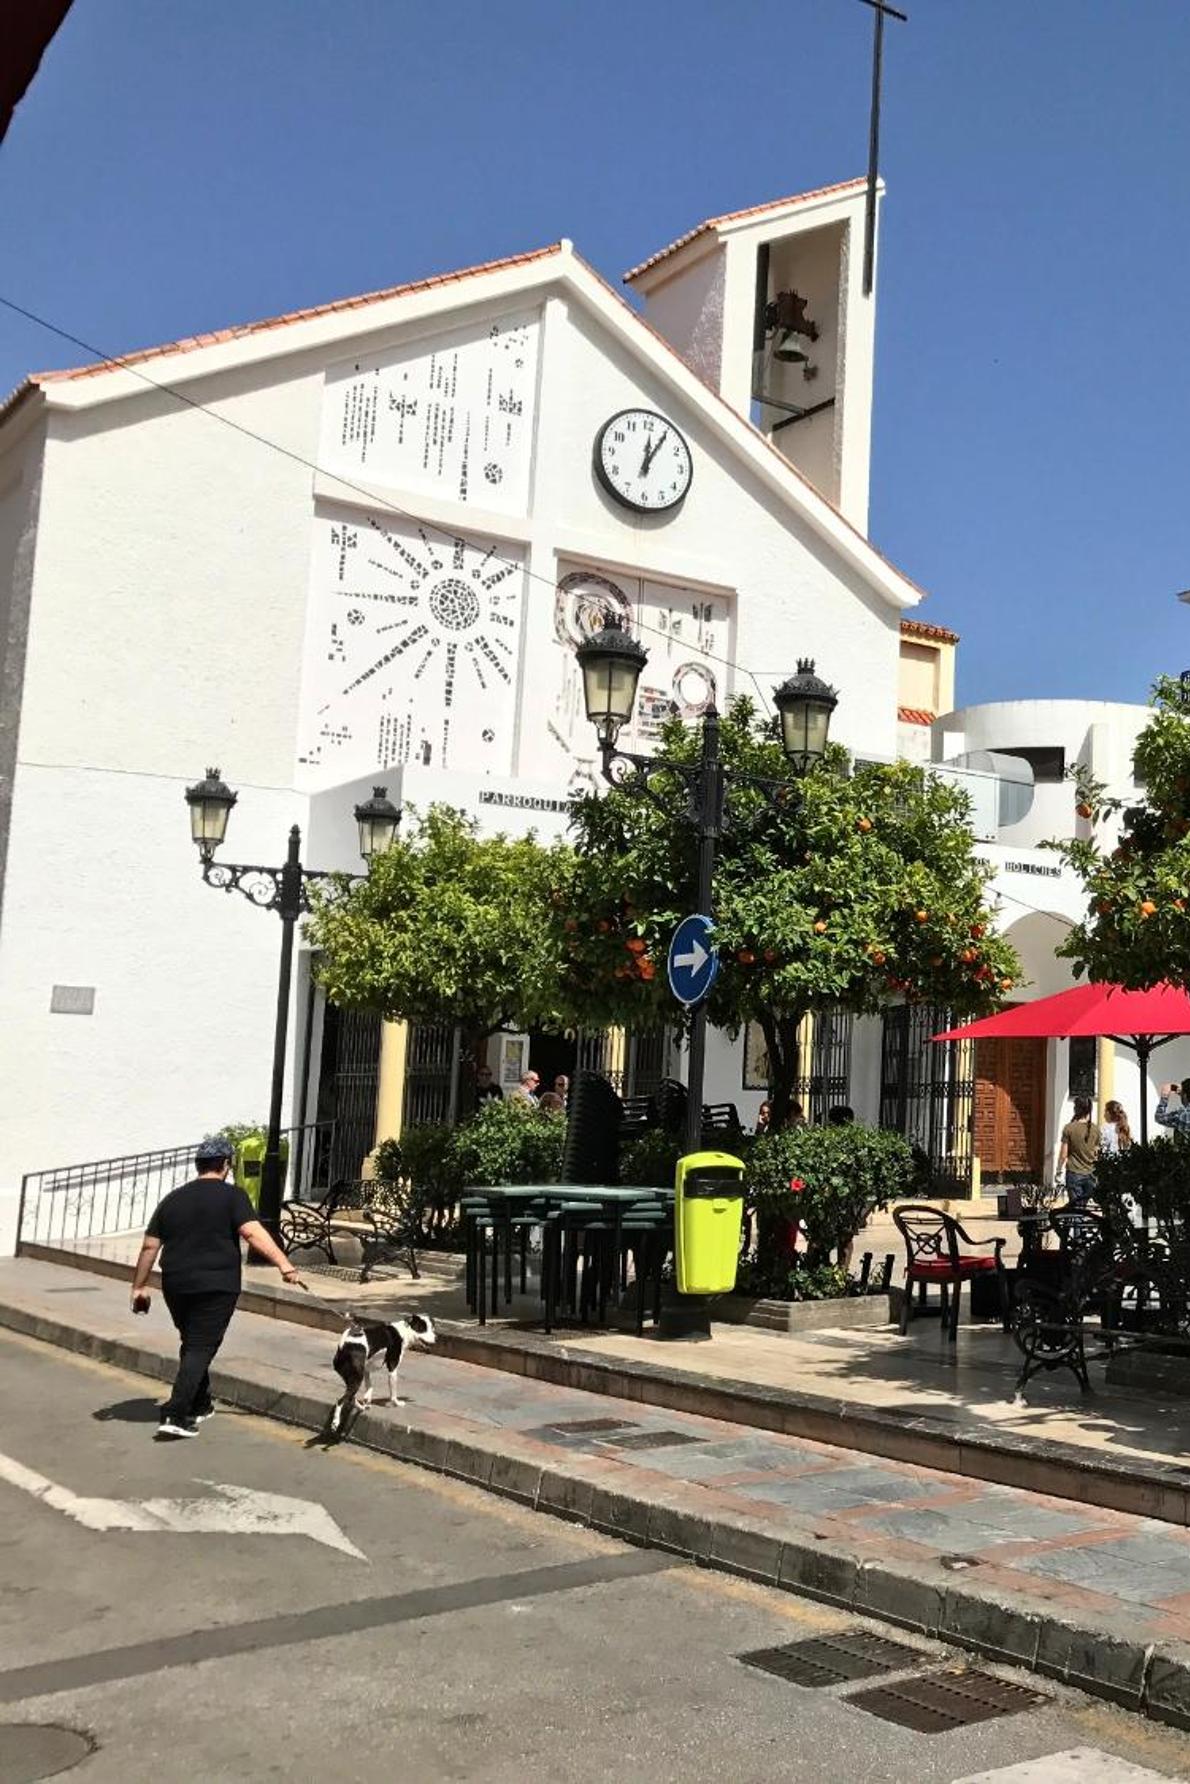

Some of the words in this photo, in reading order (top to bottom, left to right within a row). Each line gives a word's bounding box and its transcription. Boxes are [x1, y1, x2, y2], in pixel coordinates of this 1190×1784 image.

[627, 420, 637, 432] 11
[643, 420, 655, 432] 12
[614, 431, 626, 443] 10
[608, 446, 616, 456] 9
[673, 446, 680, 457] 2
[611, 464, 619, 476] 8
[677, 464, 685, 475] 3
[669, 481, 677, 491] 4
[641, 491, 648, 502] 6
[658, 491, 665, 501] 5
[478, 790, 575, 814] PARROQUIA
